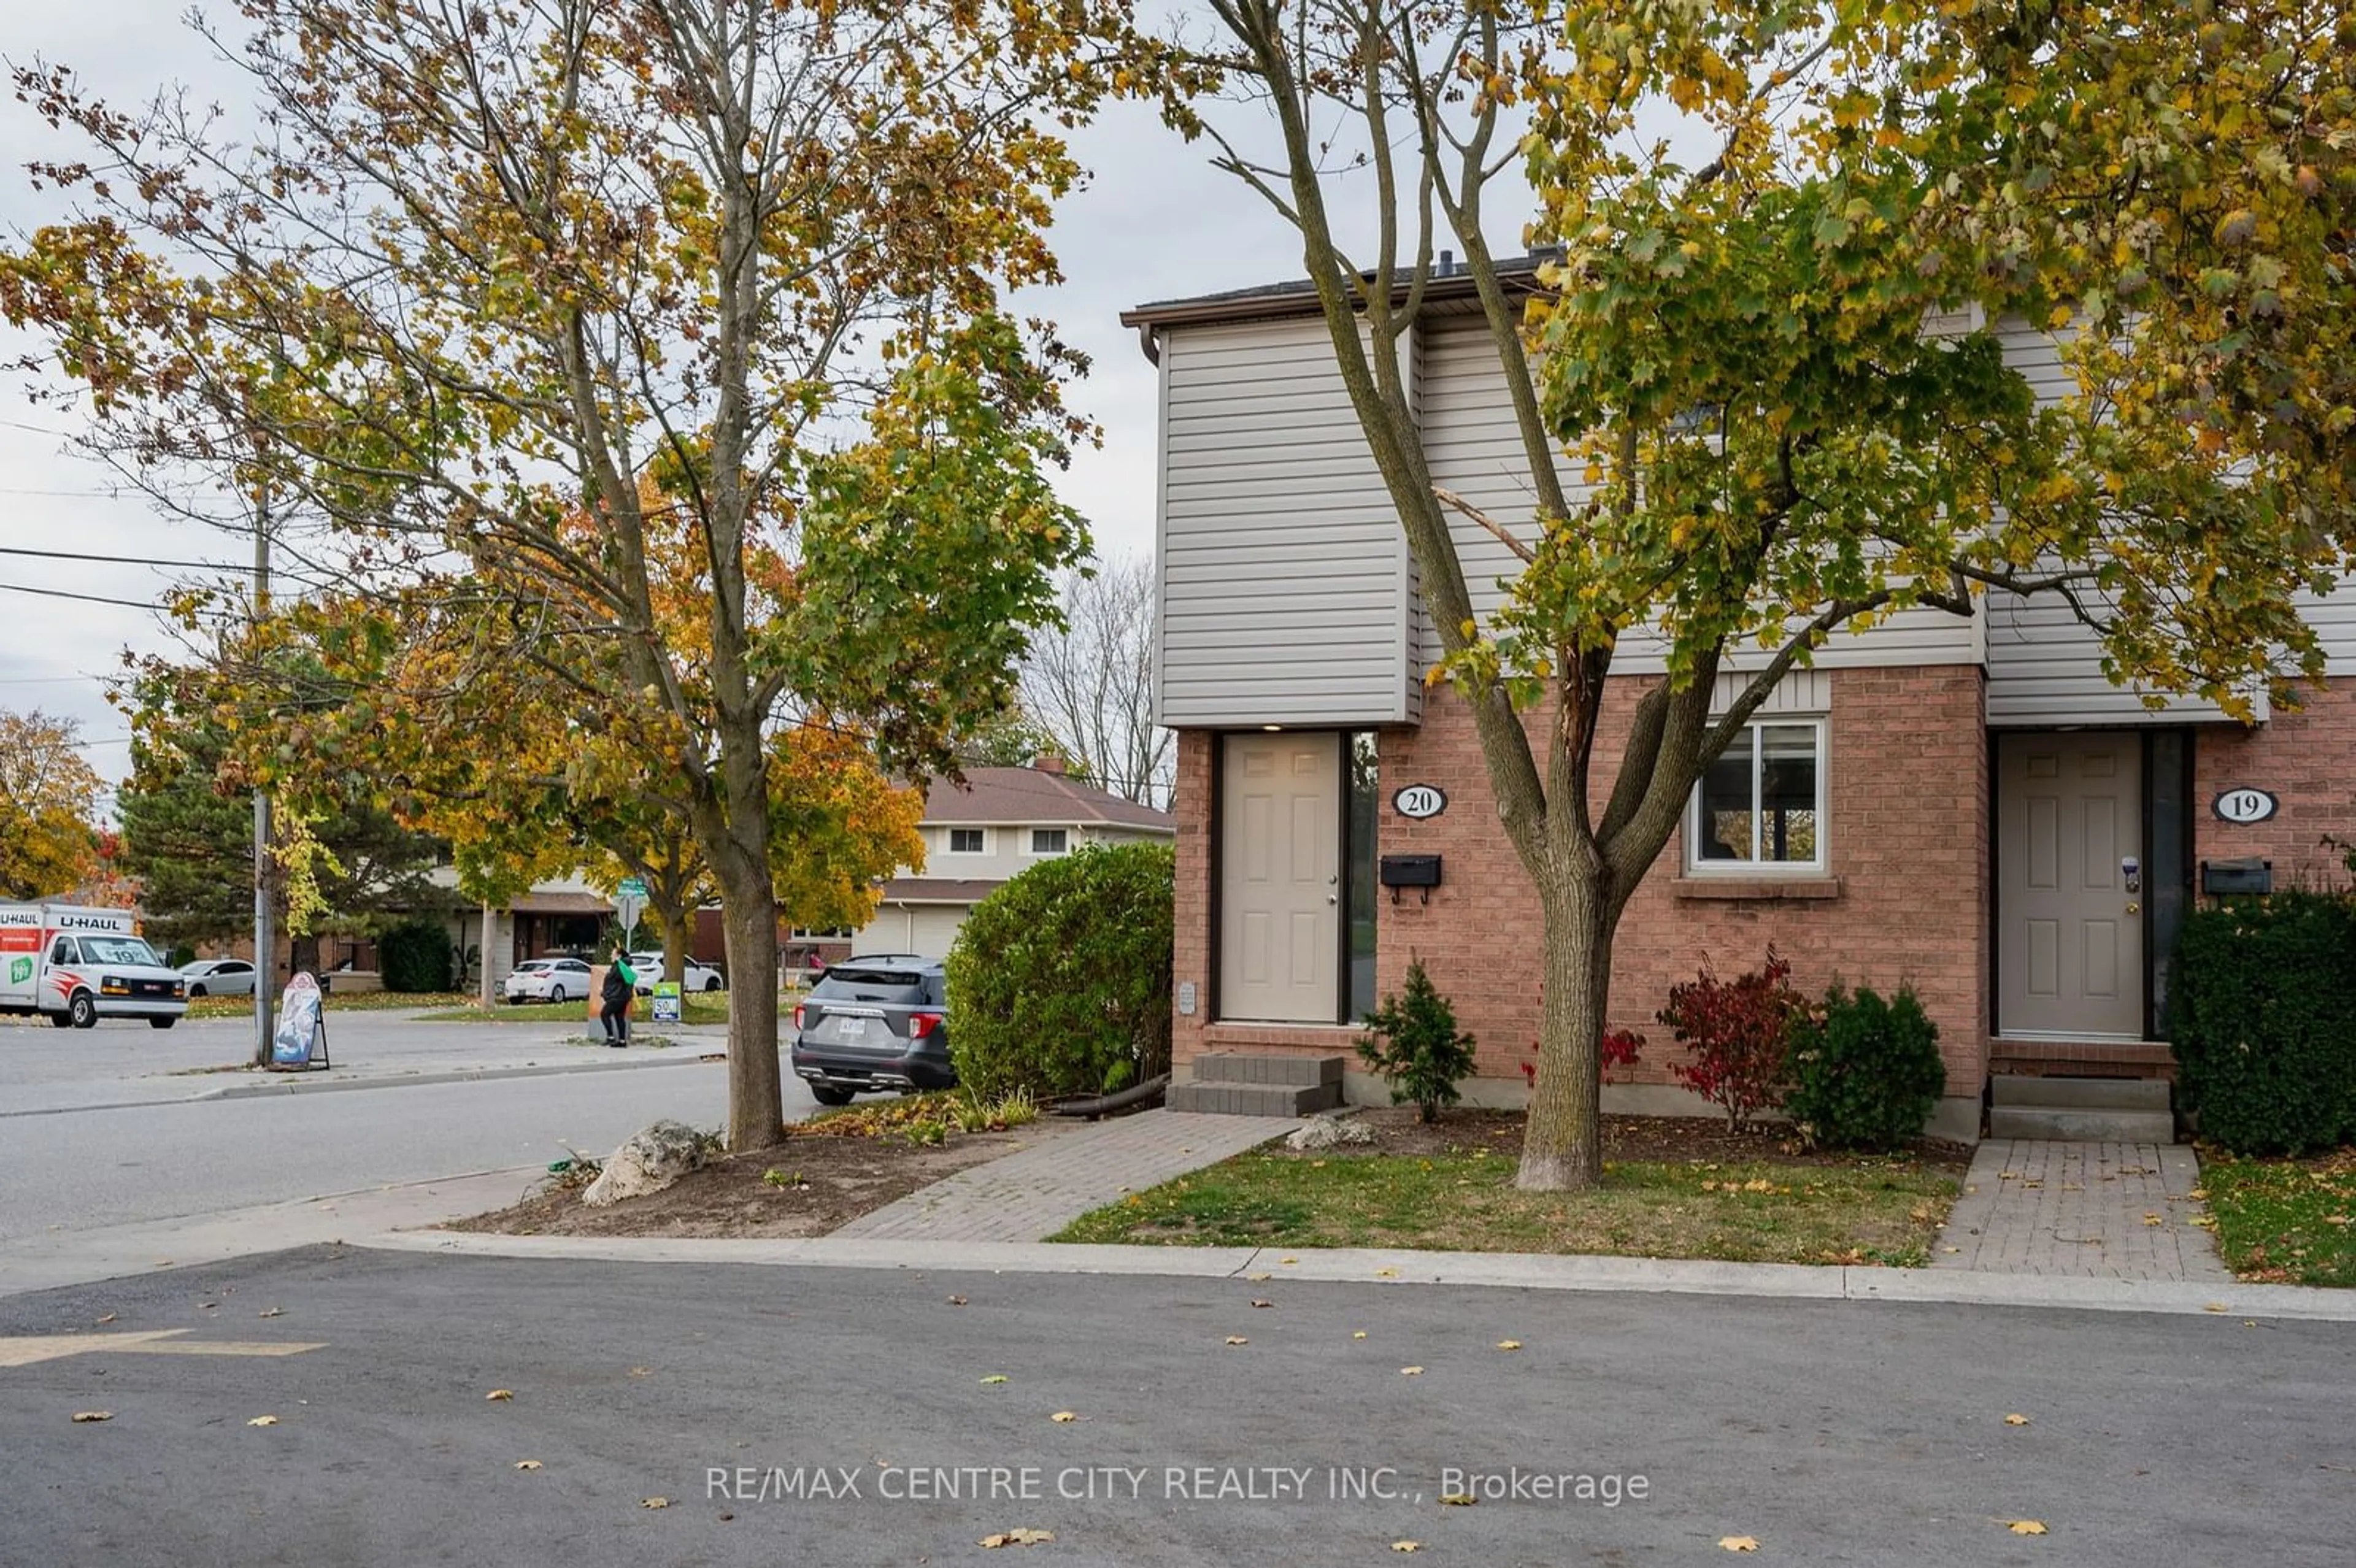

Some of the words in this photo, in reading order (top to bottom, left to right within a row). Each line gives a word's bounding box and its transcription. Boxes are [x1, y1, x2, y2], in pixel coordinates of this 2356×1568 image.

[1407, 792, 1433, 812] 20
[2233, 794, 2259, 817] 19
[1, 914, 38, 924] U-HAUL
[61, 917, 120, 930] U-HAUL
